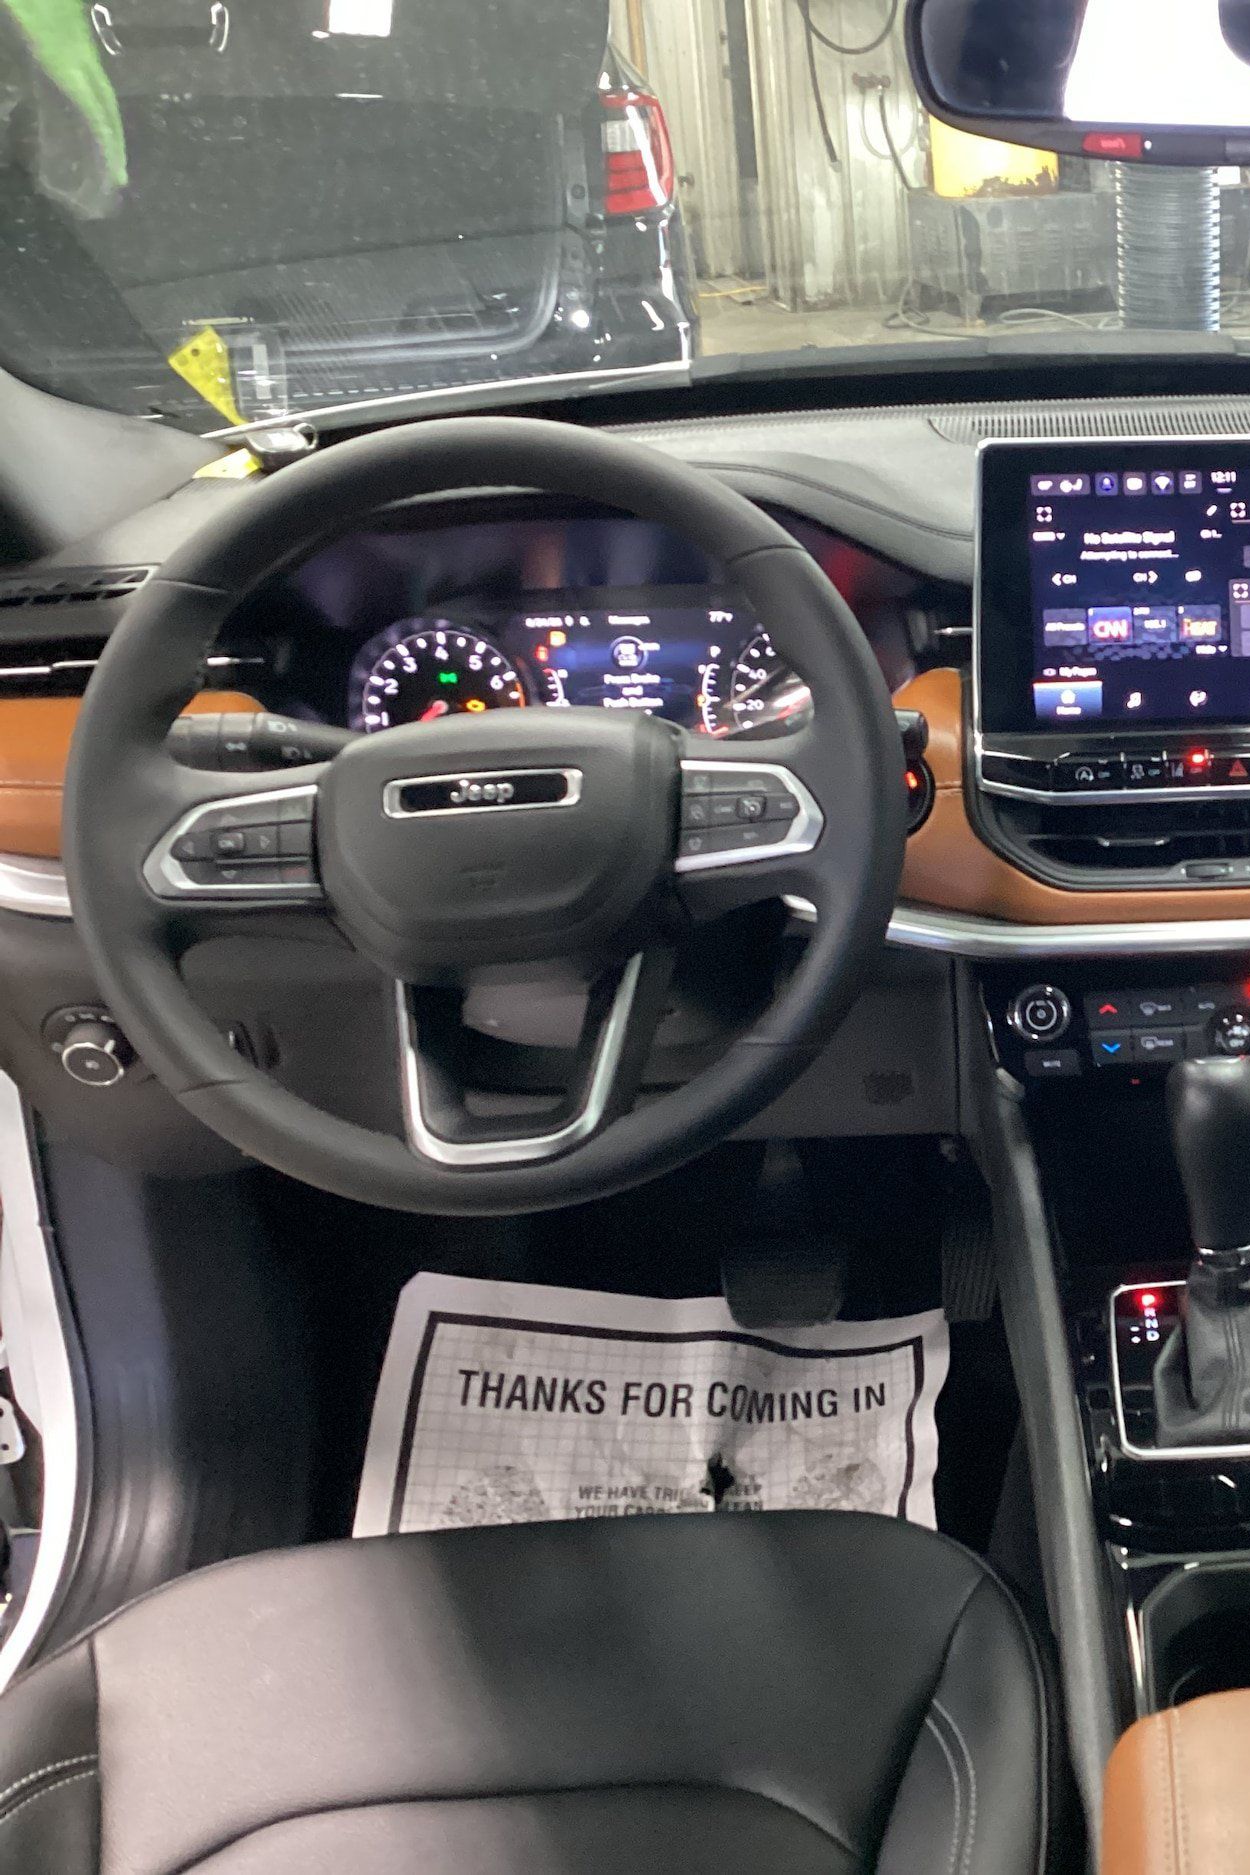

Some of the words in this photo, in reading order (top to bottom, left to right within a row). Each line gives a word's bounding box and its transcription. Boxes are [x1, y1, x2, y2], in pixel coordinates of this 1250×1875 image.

[1092, 619, 1129, 638] CNN
[402, 657, 418, 673] 3
[468, 655, 483, 671] 5
[748, 668, 767, 680] 40
[384, 678, 399, 695] 2
[490, 675, 504, 691] 6
[745, 699, 764, 711] 20
[450, 779, 514, 803] Jeep
[458, 1369, 606, 1415] THANKS
[621, 1382, 692, 1418] FOR
[707, 1381, 839, 1424] COMING
[854, 1382, 887, 1413] IN
[578, 1485, 602, 1500] WE
[608, 1485, 646, 1500] HAVE
